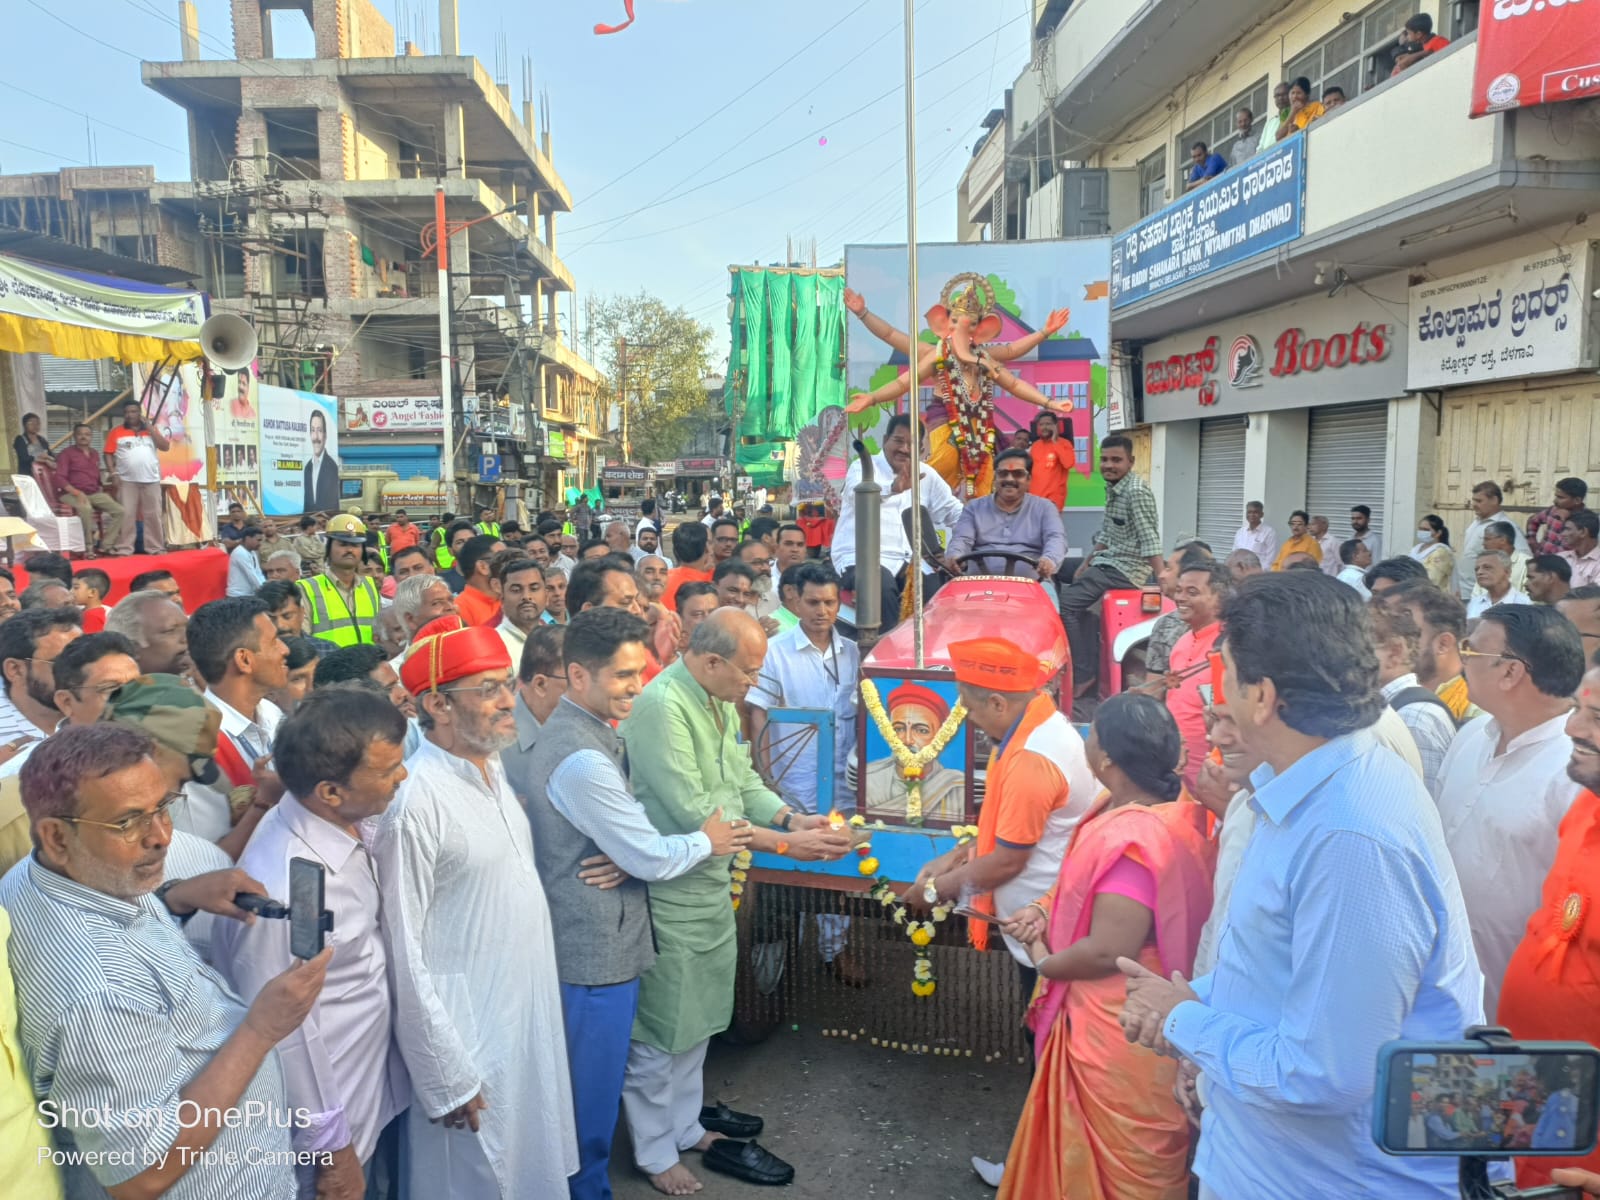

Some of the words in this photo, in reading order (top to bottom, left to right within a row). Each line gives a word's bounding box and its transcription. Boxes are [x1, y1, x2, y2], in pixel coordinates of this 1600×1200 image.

[1139, 216, 1169, 253] ಸಹಕಾರ
[1197, 178, 1239, 224] ನಿಯಮಿತ
[1242, 149, 1293, 205] ಧಾರವಾಡ
[1122, 275, 1131, 291] THE
[1132, 267, 1148, 288] RADDI
[1149, 254, 1181, 281] SAHAKARA
[1182, 243, 1202, 267] BANK
[1205, 222, 1247, 257] NIYAMITHA
[1249, 202, 1292, 238] DHARWAD
[1270, 322, 1392, 377] Boots
[1500, 344, 1535, 363] ಬೆಳಗಾವಿ
[391, 410, 416, 421] Angel
[483, 457, 495, 475] P
